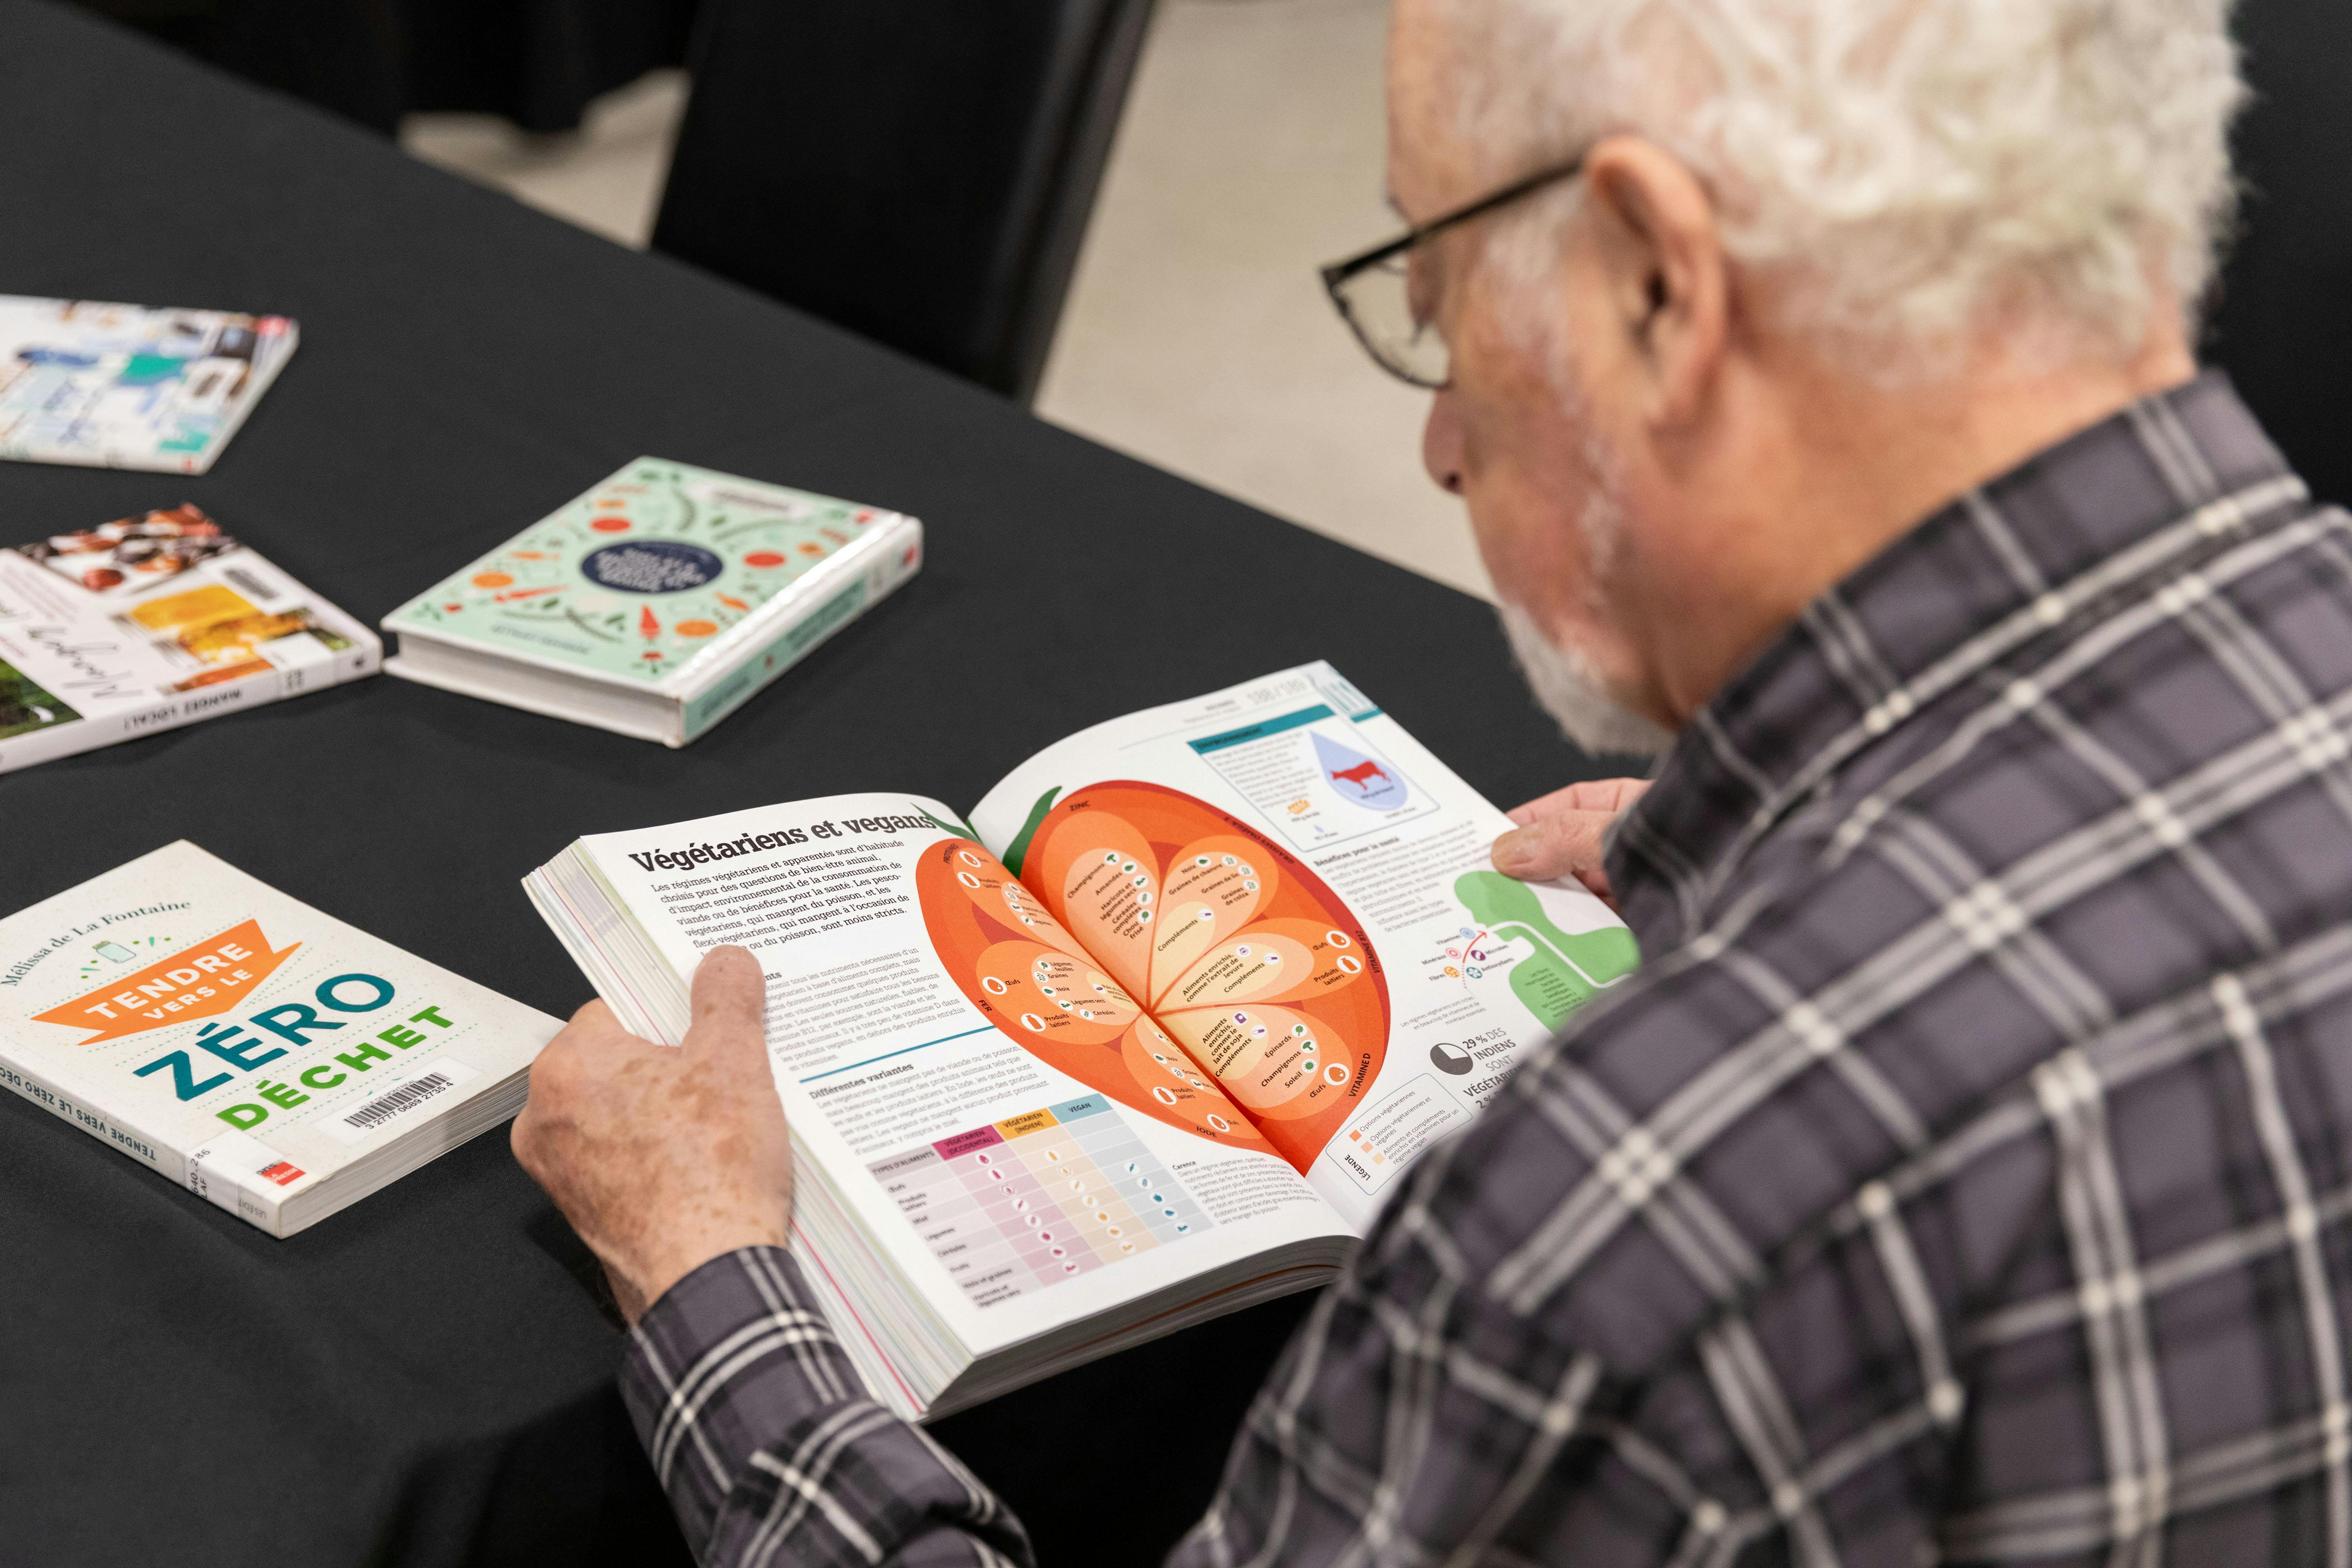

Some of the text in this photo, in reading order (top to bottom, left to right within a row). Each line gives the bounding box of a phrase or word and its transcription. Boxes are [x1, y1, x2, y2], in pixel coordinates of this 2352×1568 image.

[628, 815, 937, 871] Végétariens et vegans
[661, 892, 694, 902] choisis
[695, 888, 719, 898] pour
[739, 873, 787, 889] questions
[800, 861, 844, 873] bien-être
[845, 854, 881, 865] animal,
[671, 877, 711, 889] régimes
[712, 865, 769, 881] végétariens
[782, 851, 835, 866] apparentés
[857, 840, 904, 851] d'habitude
[669, 901, 712, 914] d'impact
[713, 882, 796, 906] environnemental
[822, 865, 889, 881] consommation
[1067, 863, 1105, 898] Champignons
[1096, 872, 1122, 895] Amandes
[677, 914, 711, 925] viande
[739, 898, 787, 913] bénéfices
[788, 891, 811, 902] pour
[824, 882, 853, 893] santé.
[871, 875, 900, 884] pesco-
[1100, 888, 1136, 920] légumes secs
[1101, 889, 1125, 910] Haricots
[1112, 902, 1136, 924] Céréales
[685, 921, 746, 936] végétariens,
[747, 915, 764, 925] qui
[765, 904, 809, 920] mangent
[824, 893, 865, 906] poisson,
[693, 926, 779, 947] flexi-végétariens,
[780, 919, 797, 929] qui
[797, 909, 842, 924] mangent
[849, 898, 897, 911] l'occasion
[778, 928, 820, 943] poisson,
[821, 921, 843, 931] sont
[843, 914, 873, 925] moins
[874, 908, 906, 918] stricts.
[1123, 922, 1138, 936] Chou
[1, 901, 191, 986] Mélissa de La Fontaine
[1130, 926, 1143, 939] frisé
[1158, 920, 1198, 951] Compléments
[1355, 931, 1380, 973] VITAMINE B12
[84, 943, 253, 1019] TENDRE
[1183, 955, 1233, 996] Aliments enrichis,
[1187, 982, 1207, 1002] comme
[1206, 964, 1230, 982] l'extrait
[1223, 963, 1243, 978] levure
[1224, 963, 1265, 992] Compléments
[1313, 968, 1339, 982] Produits
[1323, 974, 1345, 985] laitiers
[143, 969, 253, 1019] VERS LE
[978, 1000, 992, 1011] FER
[133, 973, 395, 1101] ZÉRO
[1203, 1018, 1227, 1044] Aliments
[1209, 1025, 1232, 1047] enrichis,
[1211, 1034, 1231, 1056] comme
[1463, 1027, 1506, 1049] 29 % DES
[1213, 1053, 1223, 1063] lait
[1230, 1034, 1242, 1045] soja
[1215, 1038, 1251, 1077] Compléments
[1265, 1035, 1291, 1058] Épinards
[1474, 1039, 1516, 1060] INDIENS
[215, 1005, 454, 1131] DÉCHET
[1261, 1051, 1301, 1086] Champignons
[1485, 1055, 1513, 1071] SONT
[809, 1064, 913, 1099] Différentes variantes
[1285, 1071, 1302, 1087] Soleil
[1310, 1084, 1326, 1097] Œufs
[1348, 1060, 1370, 1097] VITAMINE
[25, 1082, 54, 1105] ZÉRO
[60, 1100, 71, 1114] LE
[358, 1100, 376, 1110] VILLE
[374, 1111, 398, 1125] 2777
[398, 1099, 422, 1112] 0689
[421, 1086, 446, 1100] 2735
[1068, 1103, 1091, 1112] VEGAN
[76, 1109, 106, 1134] VERS
[1003, 1112, 1043, 1127] VÉGÉTARIEN
[1360, 1091, 1415, 1131] Options végétariennes
[1370, 1124, 1391, 1141] Options
[1390, 1101, 1425, 1125] végétariennes
[1015, 1121, 1043, 1134] (INDIEN)
[1196, 1126, 1216, 1138] IODE
[1375, 1129, 1396, 1146] veganes
[1383, 1136, 1406, 1155] Aliments
[1412, 1110, 1445, 1132] compléments
[1388, 1143, 1408, 1159] enrichis
[1415, 1121, 1439, 1138] vitamines
[1439, 1113, 1451, 1123] pour
[111, 1128, 156, 1161] TENDRE
[1393, 1138, 1426, 1164] régime vegan
[1172, 1161, 1196, 1170] Carence
[1344, 1154, 1370, 1180] LÉGENDE
